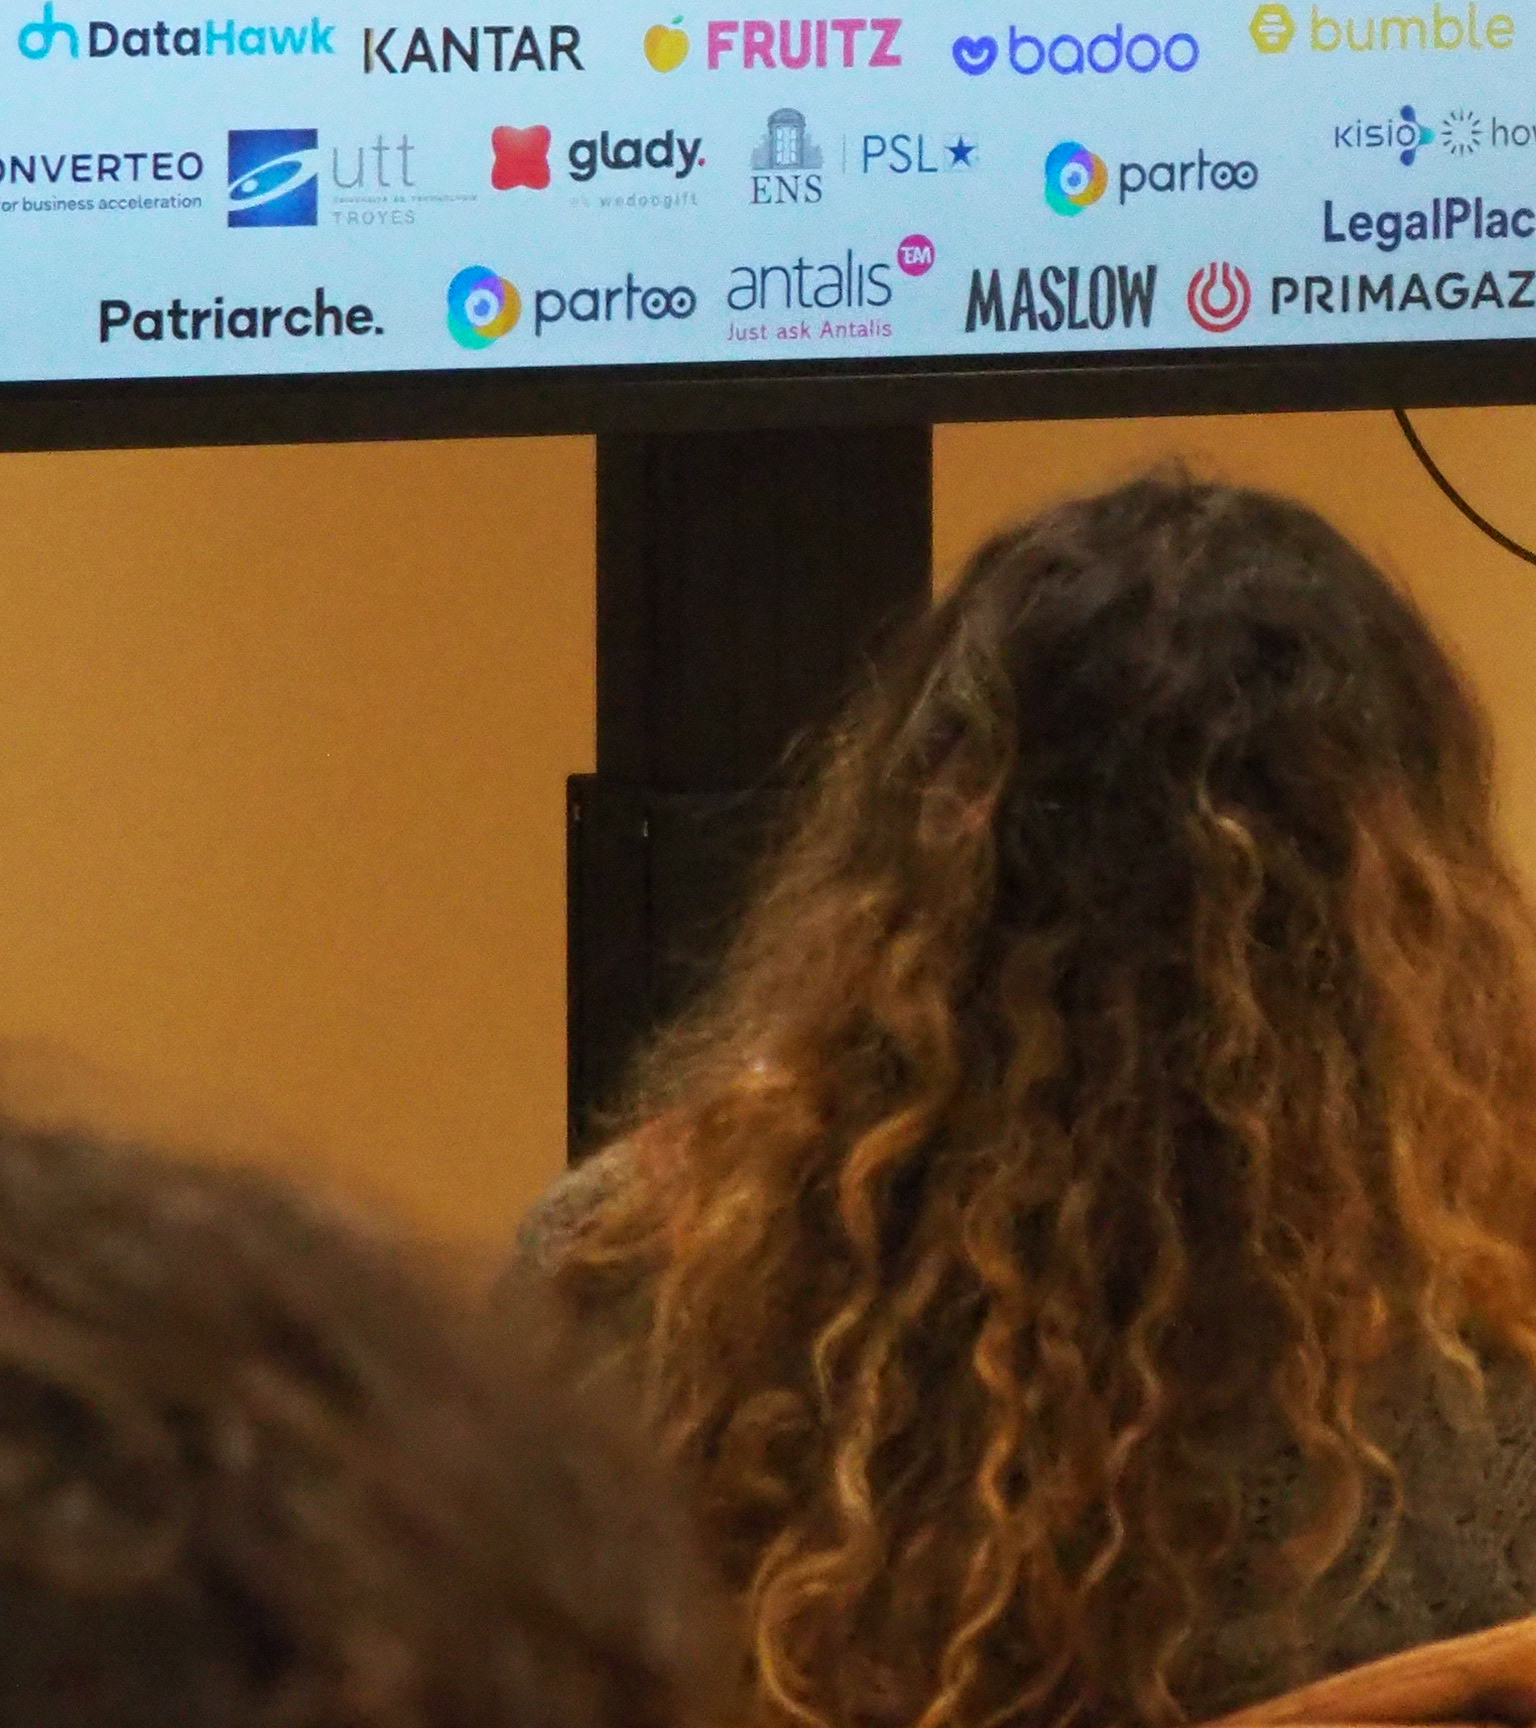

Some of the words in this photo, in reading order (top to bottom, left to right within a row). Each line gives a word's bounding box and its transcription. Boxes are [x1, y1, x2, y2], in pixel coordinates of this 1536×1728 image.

[88, 15, 336, 59] DataHawk
[363, 24, 587, 75] KANTAR
[706, 18, 903, 70] FRUITZ
[1009, 23, 1200, 75] badoo
[1310, 2, 1516, 53] bumble
[332, 134, 415, 189] utt
[862, 133, 938, 175] PSL
[1119, 148, 1259, 206] partoo
[22, 195, 95, 212] business
[98, 193, 203, 211] acceleration
[750, 174, 824, 206] ENS
[332, 209, 416, 225] TROYES
[535, 274, 697, 336] partoo
[727, 248, 893, 311] antalis
[964, 263, 1158, 334] MASLOW
[1270, 269, 1536, 317] PRIMAGAZ
[100, 287, 385, 343] Patriarche.
[727, 320, 768, 342] Just
[776, 319, 813, 341] ask
[820, 318, 893, 339] Antalis
